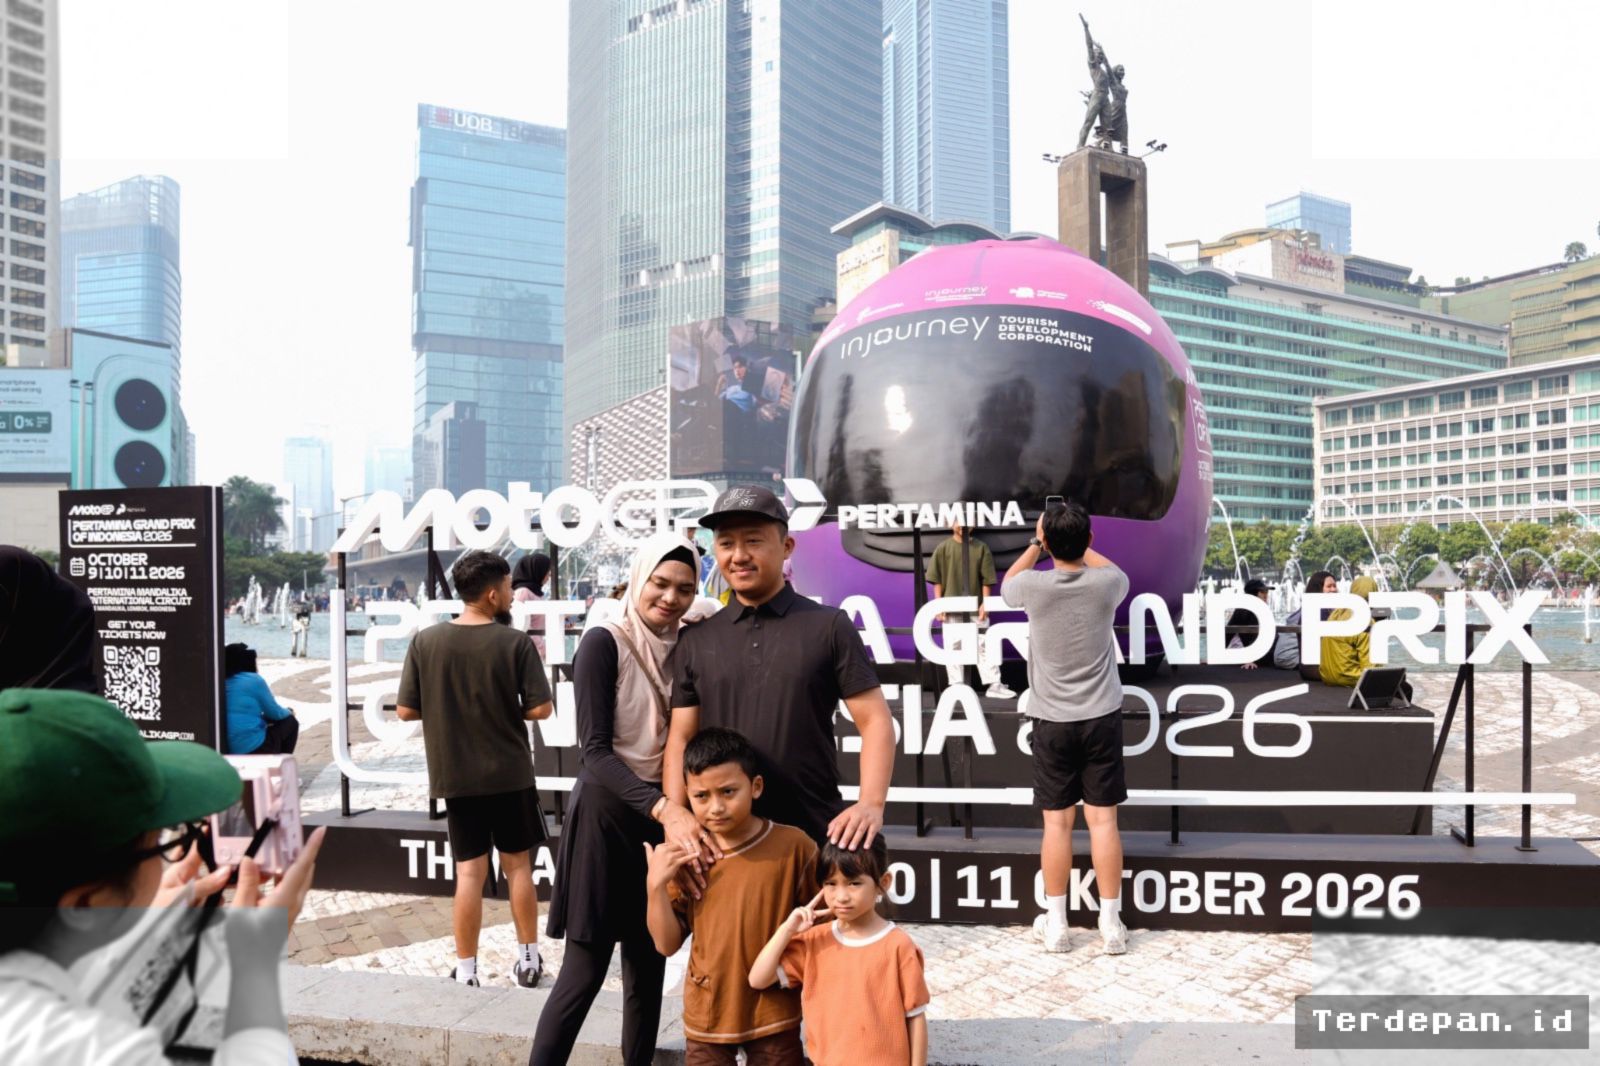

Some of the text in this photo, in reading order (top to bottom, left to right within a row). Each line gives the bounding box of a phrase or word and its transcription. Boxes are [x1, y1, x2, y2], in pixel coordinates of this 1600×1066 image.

[454, 112, 493, 132] UOB
[999, 315, 1059, 328] TOURISM
[998, 325, 1094, 345] DEVELOPMENT
[998, 332, 1093, 353] CORPORATION
[330, 479, 720, 553] MotoGP
[837, 500, 1026, 530] PERTAMINA
[72, 518, 196, 531] PERTAMINA GRAND PRIX
[72, 530, 173, 542] OF INDONESIA 2026
[88, 553, 148, 566] OCTOBER
[149, 566, 185, 580] 2026
[87, 587, 188, 598] PERTAMINA MANDALIKA
[155, 597, 192, 606] CIRCUIT
[107, 620, 156, 630] GET YOUR
[912, 591, 1276, 666] GRND
[1301, 590, 1551, 664] PRIX
[98, 630, 166, 640] TICKETS NOW
[400, 839, 454, 881] TH
[957, 865, 1019, 909] 11
[1281, 873, 1422, 919] 2026
